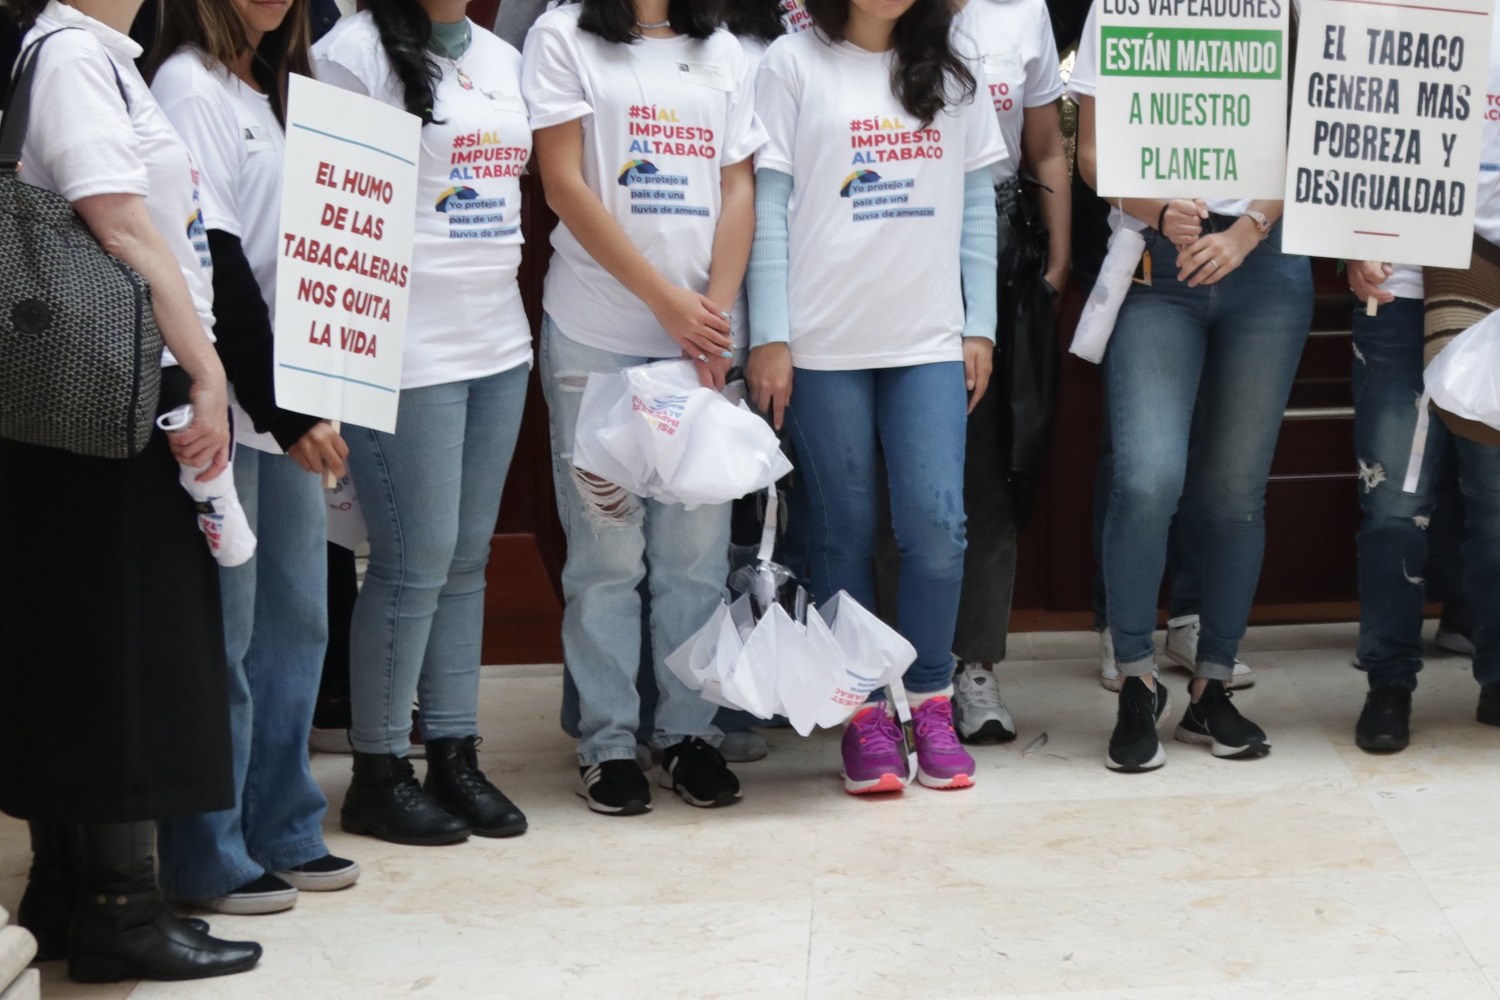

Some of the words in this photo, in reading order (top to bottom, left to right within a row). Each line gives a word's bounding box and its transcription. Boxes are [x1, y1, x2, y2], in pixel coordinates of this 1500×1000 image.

[1106, 33, 1170, 71] ESTÁN
[1177, 40, 1276, 74] MATANDO
[1323, 25, 1346, 61] EL
[1367, 28, 1464, 72] TABACO
[1129, 92, 1142, 124] A
[1150, 93, 1250, 127] NUESTRO
[1308, 72, 1399, 114] GENERA
[1417, 82, 1471, 121] MAS
[629, 122, 714, 142] IMPUESTO
[851, 129, 941, 148] IMPUESTO
[1313, 120, 1421, 165] POBREZA
[1442, 133, 1457, 168] Y
[451, 147, 528, 164] IMPUESTO
[1141, 147, 1238, 181] PLANETA
[316, 161, 337, 189] EL
[342, 169, 393, 204] HUMO
[630, 175, 642, 183] Yo
[645, 176, 678, 185] protejo
[680, 177, 688, 185] al
[654, 190, 665, 198] de
[668, 192, 684, 200] una
[852, 185, 864, 193] Yo
[867, 182, 902, 193] protejo
[905, 180, 914, 188] al
[1296, 167, 1465, 216] DESIGUALDAD
[465, 200, 497, 210] protejo
[498, 198, 505, 207] al
[631, 204, 658, 214] lluvia
[660, 206, 672, 214] de
[853, 211, 879, 222] lluvia
[321, 203, 348, 230] DE
[351, 211, 384, 241] LAS
[449, 229, 478, 238] lluvia
[480, 229, 492, 237] de
[285, 232, 408, 288] TABACALERAS
[298, 277, 337, 308] NOS
[342, 288, 390, 322] QUITA
[309, 320, 332, 347] LA
[340, 326, 377, 358] VIDA
